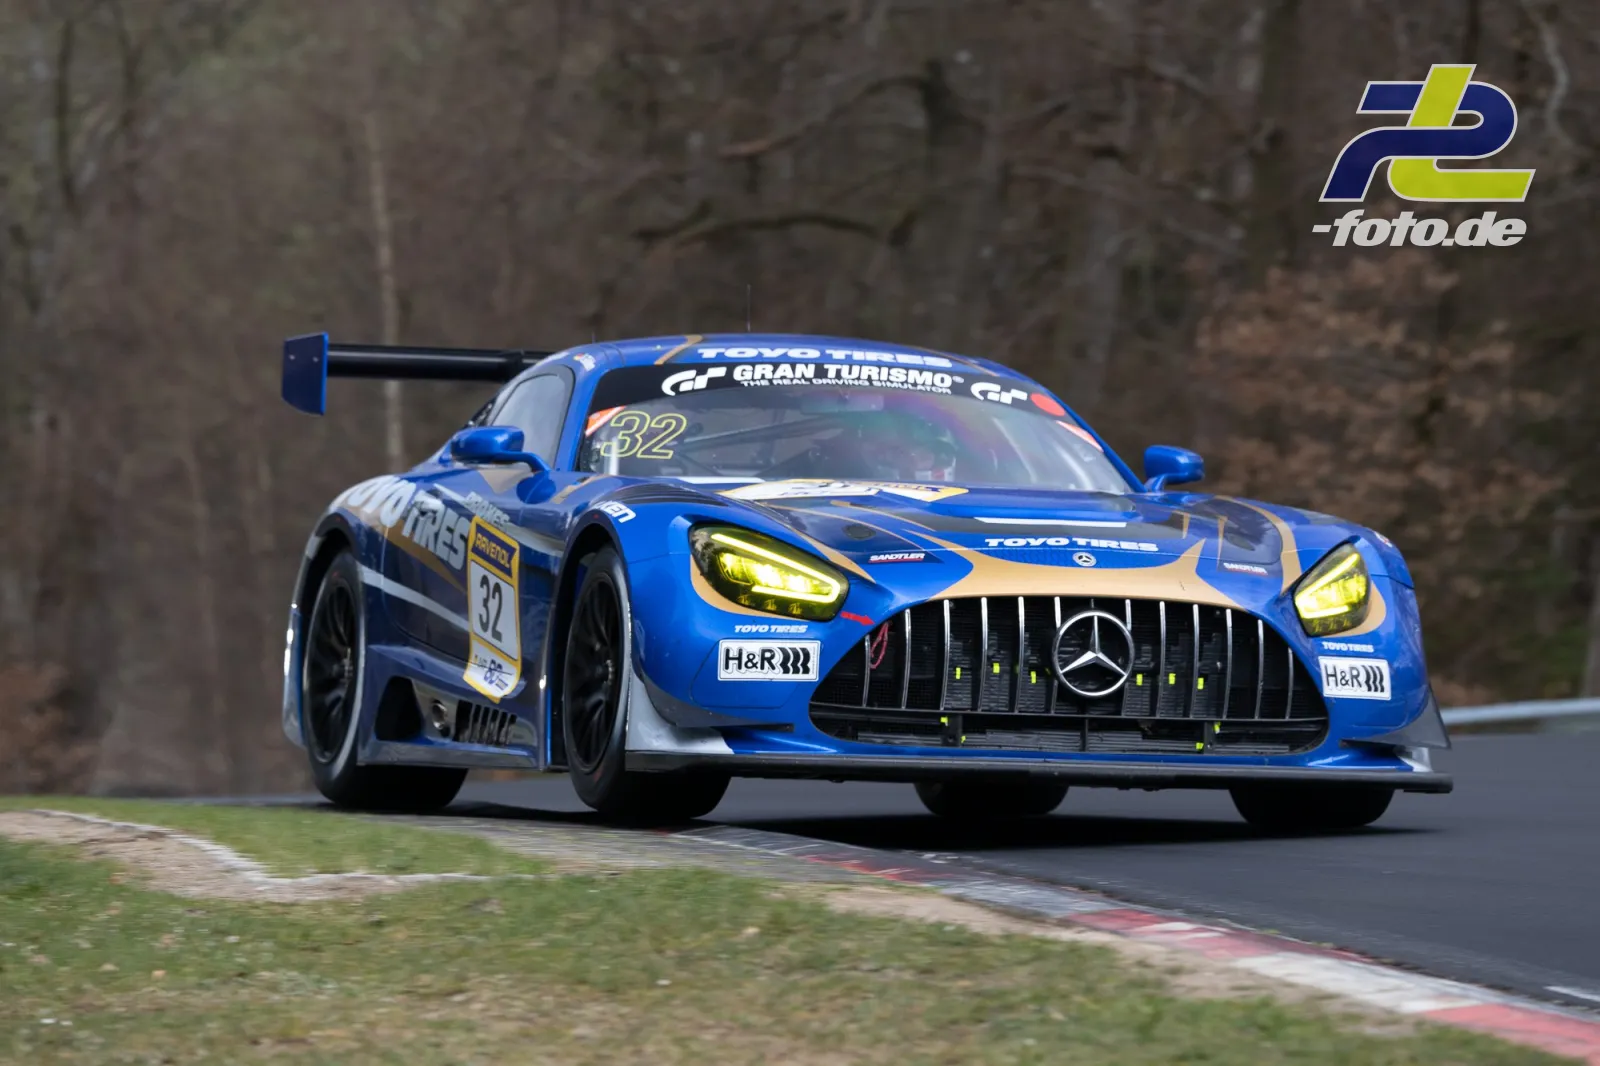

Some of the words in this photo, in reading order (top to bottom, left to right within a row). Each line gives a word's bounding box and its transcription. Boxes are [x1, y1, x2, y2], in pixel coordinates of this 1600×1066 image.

[698, 347, 821, 359] TOYO
[825, 349, 953, 368] TIRES
[732, 363, 815, 382] GRAN
[740, 379, 770, 387] THE
[772, 378, 810, 386] REAL
[812, 378, 870, 386] DRIVING
[872, 380, 952, 395] SIMULATOR
[600, 410, 687, 459] 32
[401, 489, 472, 571] TIRES
[475, 532, 511, 569] RAVENOL
[984, 537, 1070, 547] TOYO
[1072, 537, 1159, 552] TIRES
[869, 552, 926, 562] SANDTLER
[478, 574, 503, 644] 32
[734, 624, 770, 633] TOYO
[769, 624, 809, 633] TIRES
[1321, 640, 1348, 651] TOYO
[723, 646, 778, 674] H&R
[1323, 663, 1363, 689] H&R
